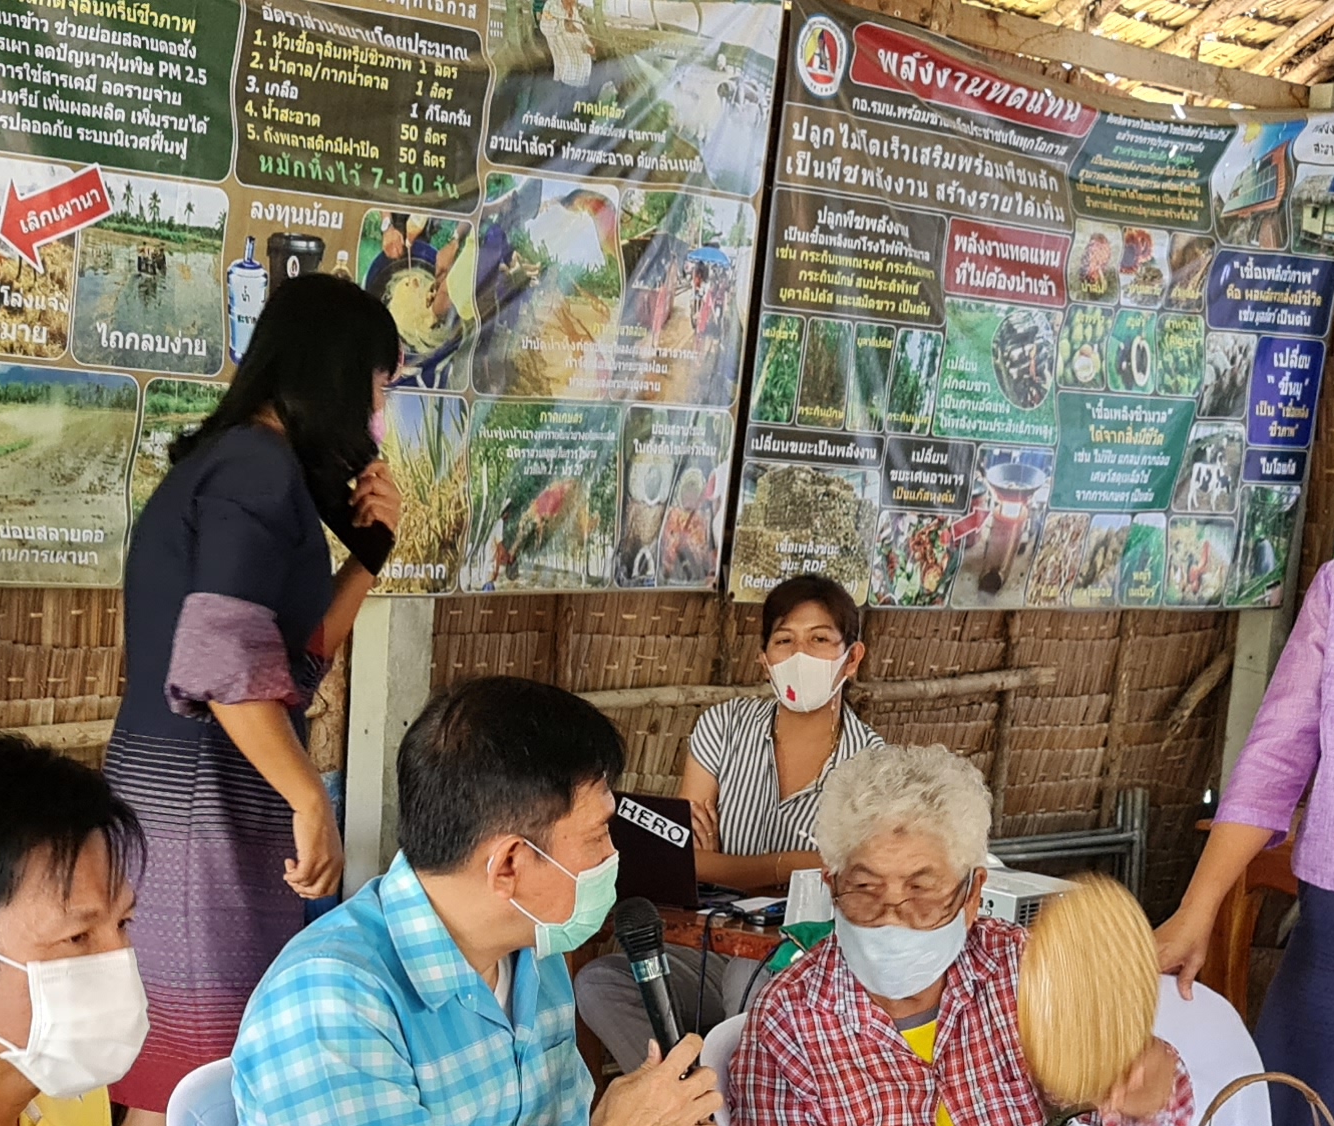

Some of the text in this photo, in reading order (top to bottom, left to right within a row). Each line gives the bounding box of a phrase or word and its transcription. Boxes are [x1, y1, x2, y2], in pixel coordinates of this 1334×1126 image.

[34, 42, 154, 76] ลดปัญหาฝุ่นพิษ
[158, 63, 181, 82] PM
[185, 67, 207, 86] 2.5
[253, 29, 267, 47] 1.
[271, 30, 412, 73] หัวเชื้อจุลินทรีย์ชีวภาพ
[419, 60, 427, 76] 1
[101, 78, 182, 107] ลดรายจ่าย
[249, 52, 264, 70] 2.
[269, 53, 389, 91] น้ำตาล/กากน้ำตาล
[415, 80, 423, 96] 1
[877, 48, 1084, 123] พลังงานทดแทน
[43, 93, 126, 123] เพิ่มผลผลิต
[131, 106, 209, 136] เพิ่มรายได้
[245, 76, 260, 94] 3.
[265, 77, 299, 100] เกลือ
[410, 102, 418, 118] 1
[244, 100, 258, 118] 4.
[261, 99, 321, 128] น้ำสะอาด
[400, 124, 419, 142] 50
[76, 125, 189, 161] ระบบนิเวศฟื้นฟู
[247, 124, 260, 141] 5.
[399, 147, 417, 165] 50
[259, 153, 460, 200] หมักทิ้งไว้ 7-10 วัน
[19, 186, 102, 234] เลิกเผานา
[251, 201, 344, 230] ลงทุนน้อย
[936, 179, 1065, 223] สร้างรายได้เพิ่ม
[954, 232, 1061, 268] พลังงานทดแทน
[954, 256, 1057, 298] ที่ไม่ต้องนำเข้า
[96, 323, 207, 358] ไถกลบง่าย
[751, 433, 877, 462] เปลี่ยนขยะเป็นพลังงาน
[911, 446, 948, 466] เปลี่ยน
[620, 801, 684, 843] HERO
